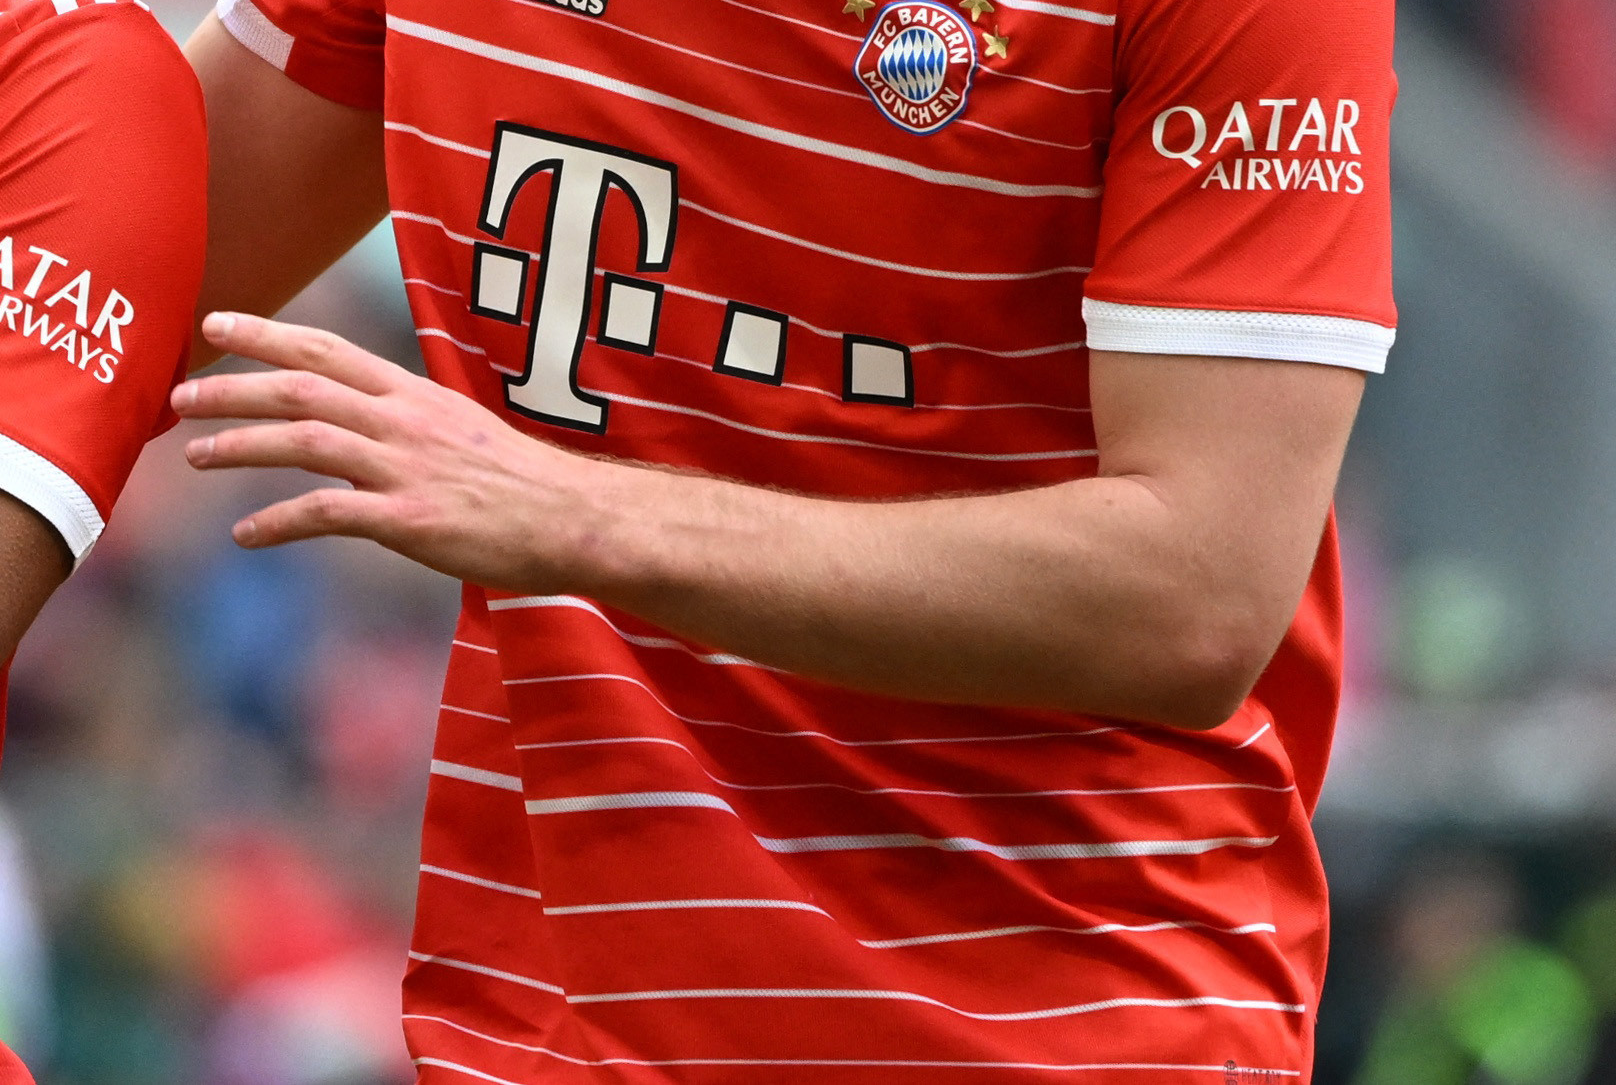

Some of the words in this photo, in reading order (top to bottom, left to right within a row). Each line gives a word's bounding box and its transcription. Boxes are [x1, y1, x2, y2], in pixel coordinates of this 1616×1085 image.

[872, 19, 897, 50] FC
[897, 7, 969, 64] BAYERN
[862, 70, 961, 125] MÜNCHEN
[1152, 97, 1362, 169] QATAR
[1200, 157, 1365, 195] AIRWAYS
[477, 121, 678, 435] T
